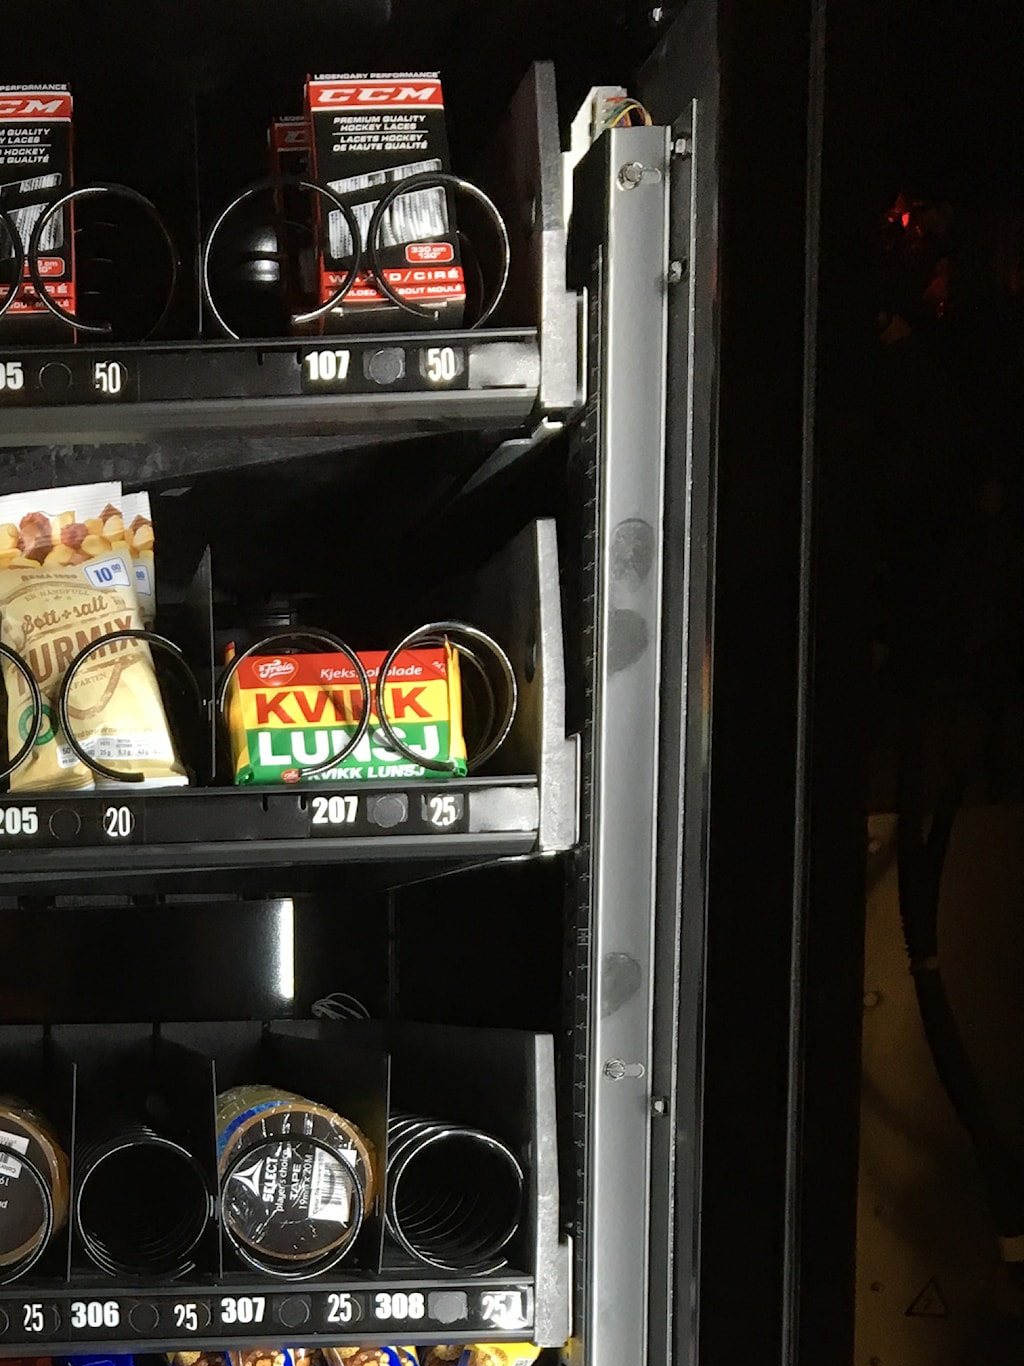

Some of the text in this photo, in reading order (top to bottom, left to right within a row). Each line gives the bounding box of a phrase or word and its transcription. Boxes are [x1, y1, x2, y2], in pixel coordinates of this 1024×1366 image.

[318, 87, 437, 102] CCM
[333, 114, 426, 124] PREMIUM QUALITY
[94, 362, 121, 394] 50
[304, 348, 455, 382] 107 50
[93, 568, 113, 583] 10
[255, 687, 433, 725] KVIKK
[258, 725, 440, 766] LUNSJ
[308, 765, 425, 780] KVIKK LUNSJ
[105, 806, 131, 837] 20
[311, 795, 457, 827] 207 25
[262, 1156, 278, 1202] SELECT
[290, 1163, 301, 1200] TAPE
[23, 1303, 44, 1332] 25
[71, 1301, 198, 1331] 306 25
[220, 1293, 353, 1324] 307 25
[375, 1292, 425, 1320] 308
